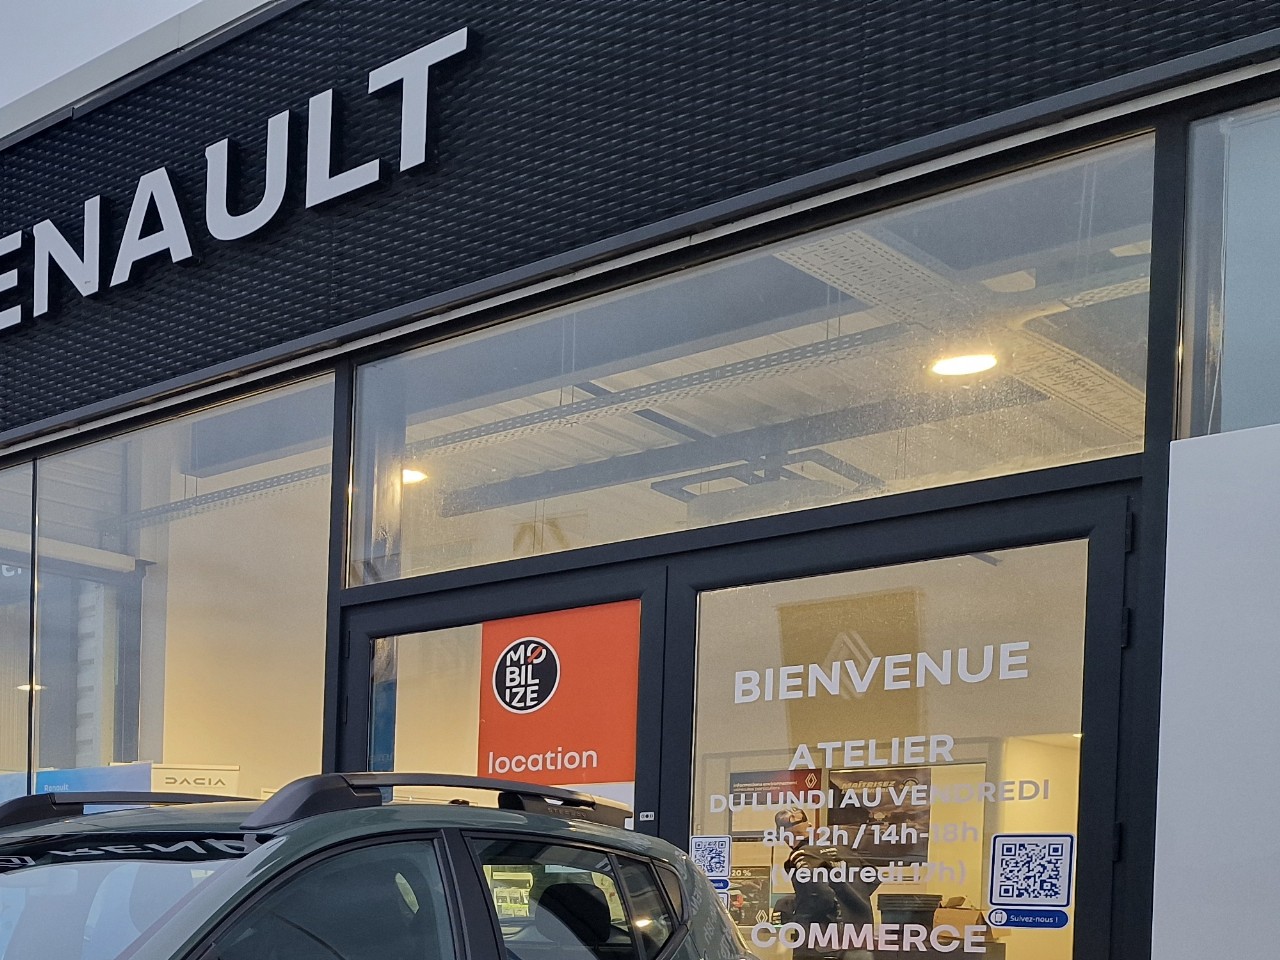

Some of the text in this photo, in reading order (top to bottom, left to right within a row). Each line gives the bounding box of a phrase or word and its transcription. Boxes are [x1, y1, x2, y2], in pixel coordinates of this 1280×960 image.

[733, 641, 1030, 704] BIENVENUE
[488, 747, 598, 775] location
[788, 734, 955, 771] ATELIER
[164, 777, 227, 786] DACIA
[709, 779, 1050, 813] DU LUNDI AU VENDREDI
[762, 823, 848, 847] 8h-12h
[871, 821, 979, 845] 14h-18h
[1009, 914, 1054, 923] Suivez-nous
[750, 922, 988, 953] COMMERCE
